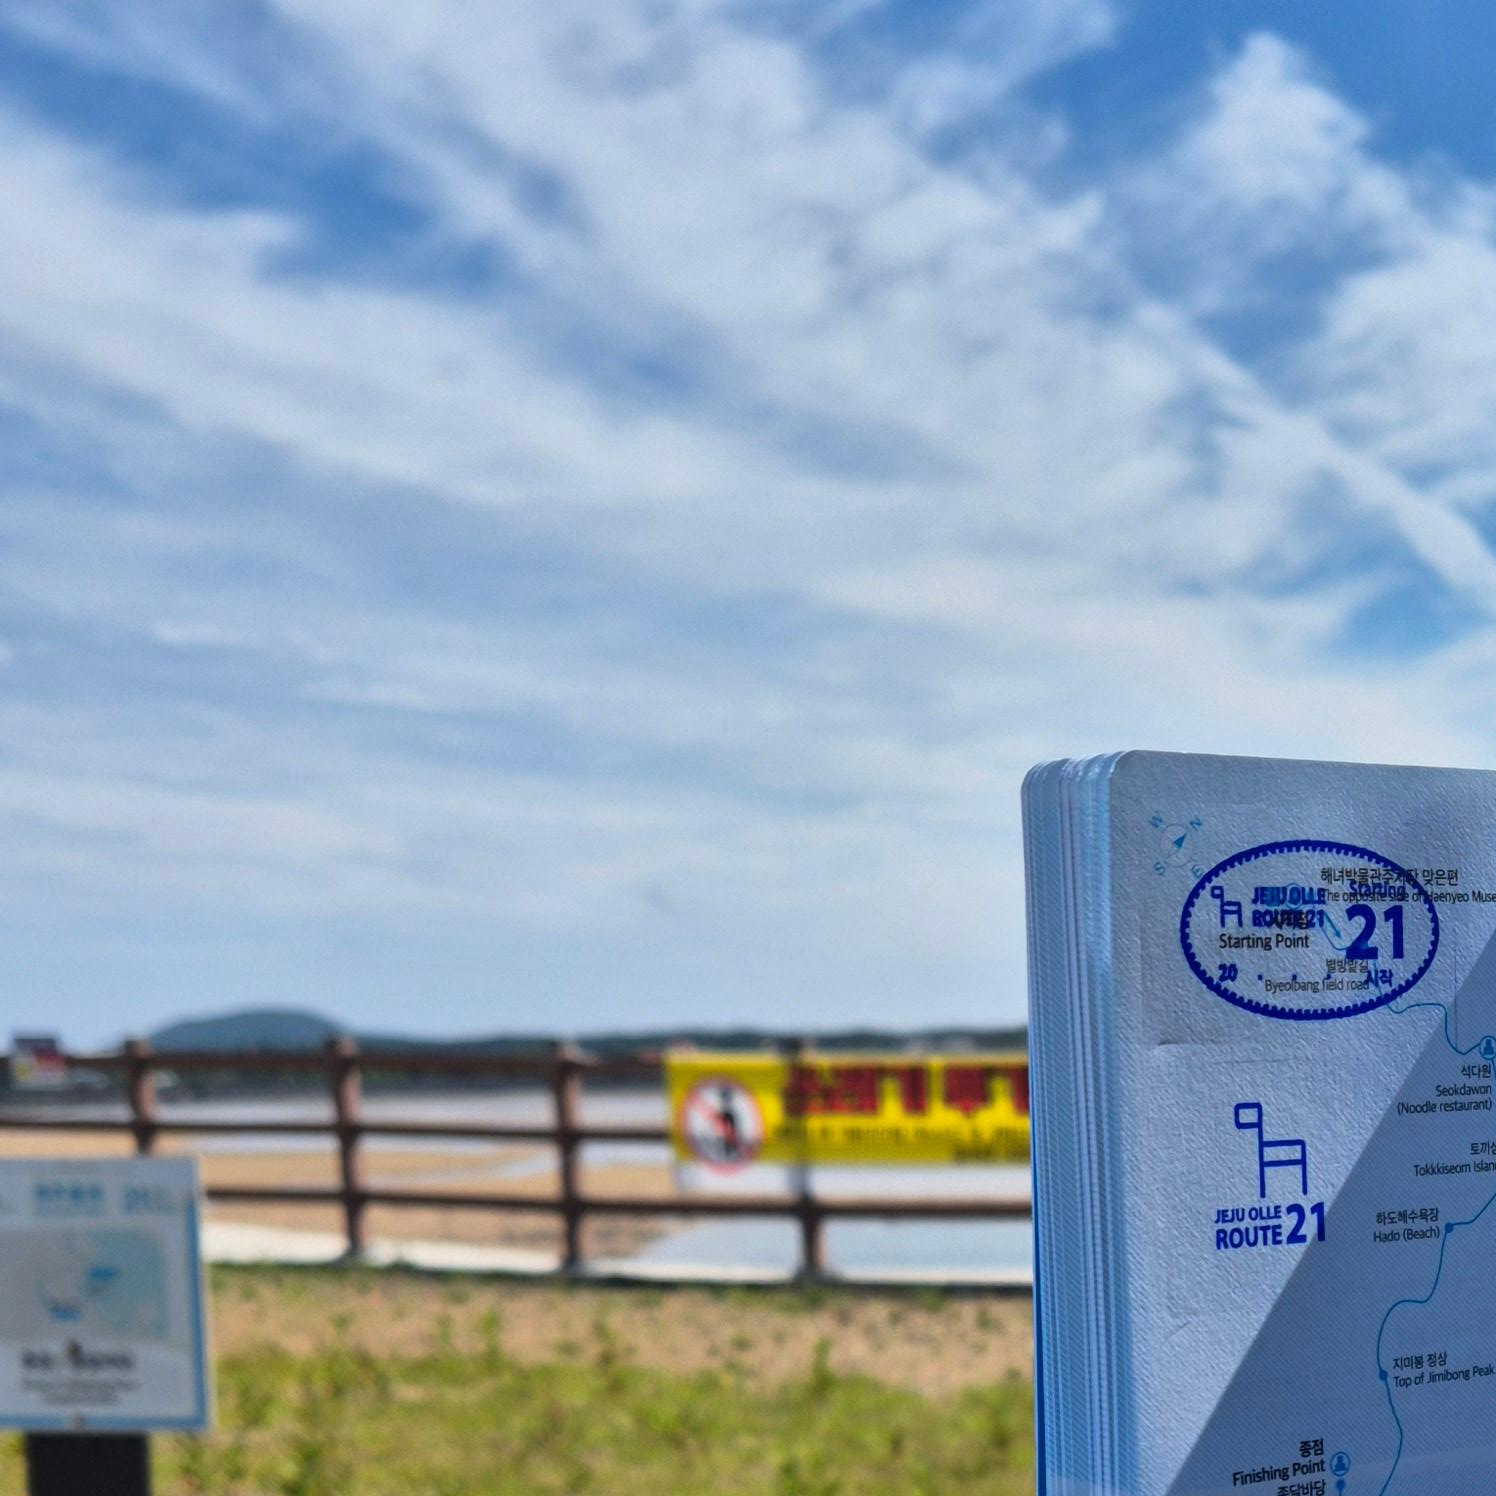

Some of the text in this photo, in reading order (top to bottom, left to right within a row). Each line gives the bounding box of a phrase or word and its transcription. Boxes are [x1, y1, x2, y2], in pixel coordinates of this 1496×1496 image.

[1422, 869, 1458, 886] 맞은편
[1345, 904, 1404, 960] 21
[1219, 934, 1309, 950] Starting Point
[1218, 964, 1238, 982] 20
[1265, 978, 1369, 993] Byeolbang field road
[1461, 1064, 1492, 1079] 석다원
[1436, 1083, 1492, 1097] Seokdawon
[1397, 1097, 1492, 1115] (Noodle restaurant)
[1215, 1205, 1282, 1224] JEJU OLLE
[1376, 1209, 1439, 1225] 하도해수욕장
[1216, 1202, 1325, 1250] ROUTE 21
[1374, 1226, 1440, 1243] Hado (Beach)
[1393, 1352, 1447, 1370] 지미봉 정상
[1394, 1364, 1495, 1389] Top of Jimibong Peak
[1300, 1439, 1324, 1457] 종점
[1233, 1459, 1325, 1487] Finishing Point
